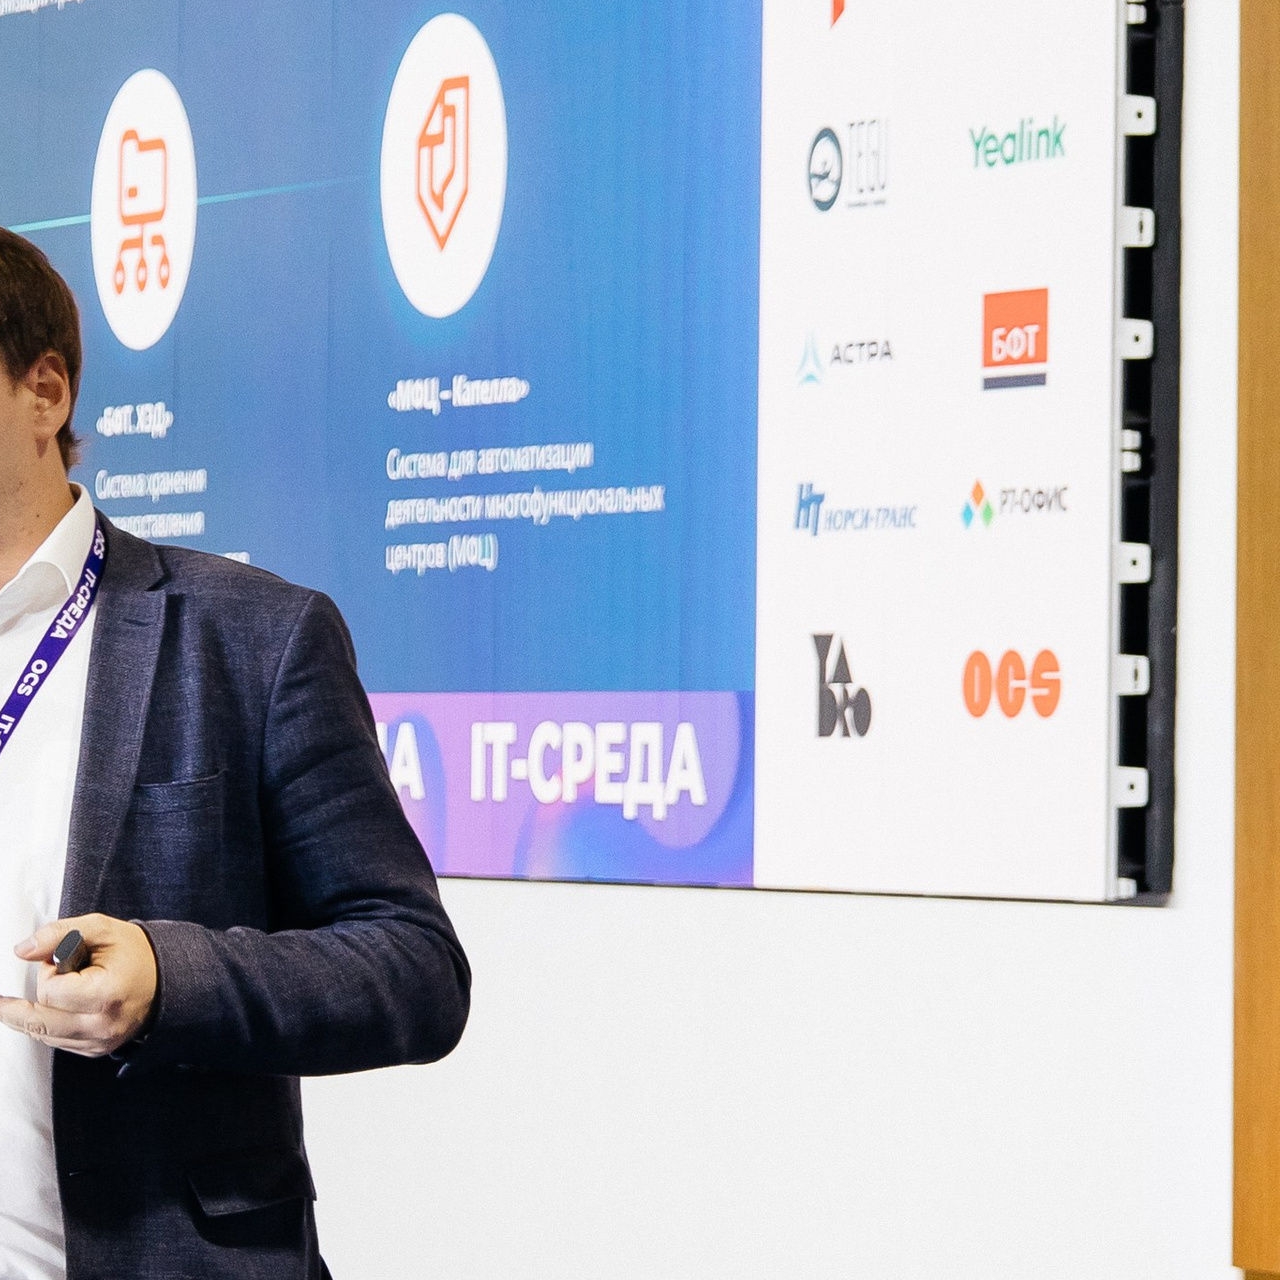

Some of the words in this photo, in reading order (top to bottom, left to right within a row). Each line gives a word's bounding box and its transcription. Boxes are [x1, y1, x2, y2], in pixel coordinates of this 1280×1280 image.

[969, 115, 1066, 169] Yealink
[830, 339, 894, 365] АСТРА
[387, 448, 448, 480] Система
[448, 450, 477, 480] для
[477, 442, 594, 474] автоматизации
[95, 469, 146, 500] Система
[147, 469, 207, 503] хранения
[385, 496, 484, 530] деятельности
[485, 485, 666, 526] многофункциональных
[824, 506, 918, 531] НОРСИ-ТРАНС
[385, 543, 448, 576] центров
[50, 568, 97, 640] IT-СРЕДА
[17, 659, 48, 697] OCS
[963, 649, 1061, 718] OCS
[470, 720, 708, 820] IT-СРЕДА
